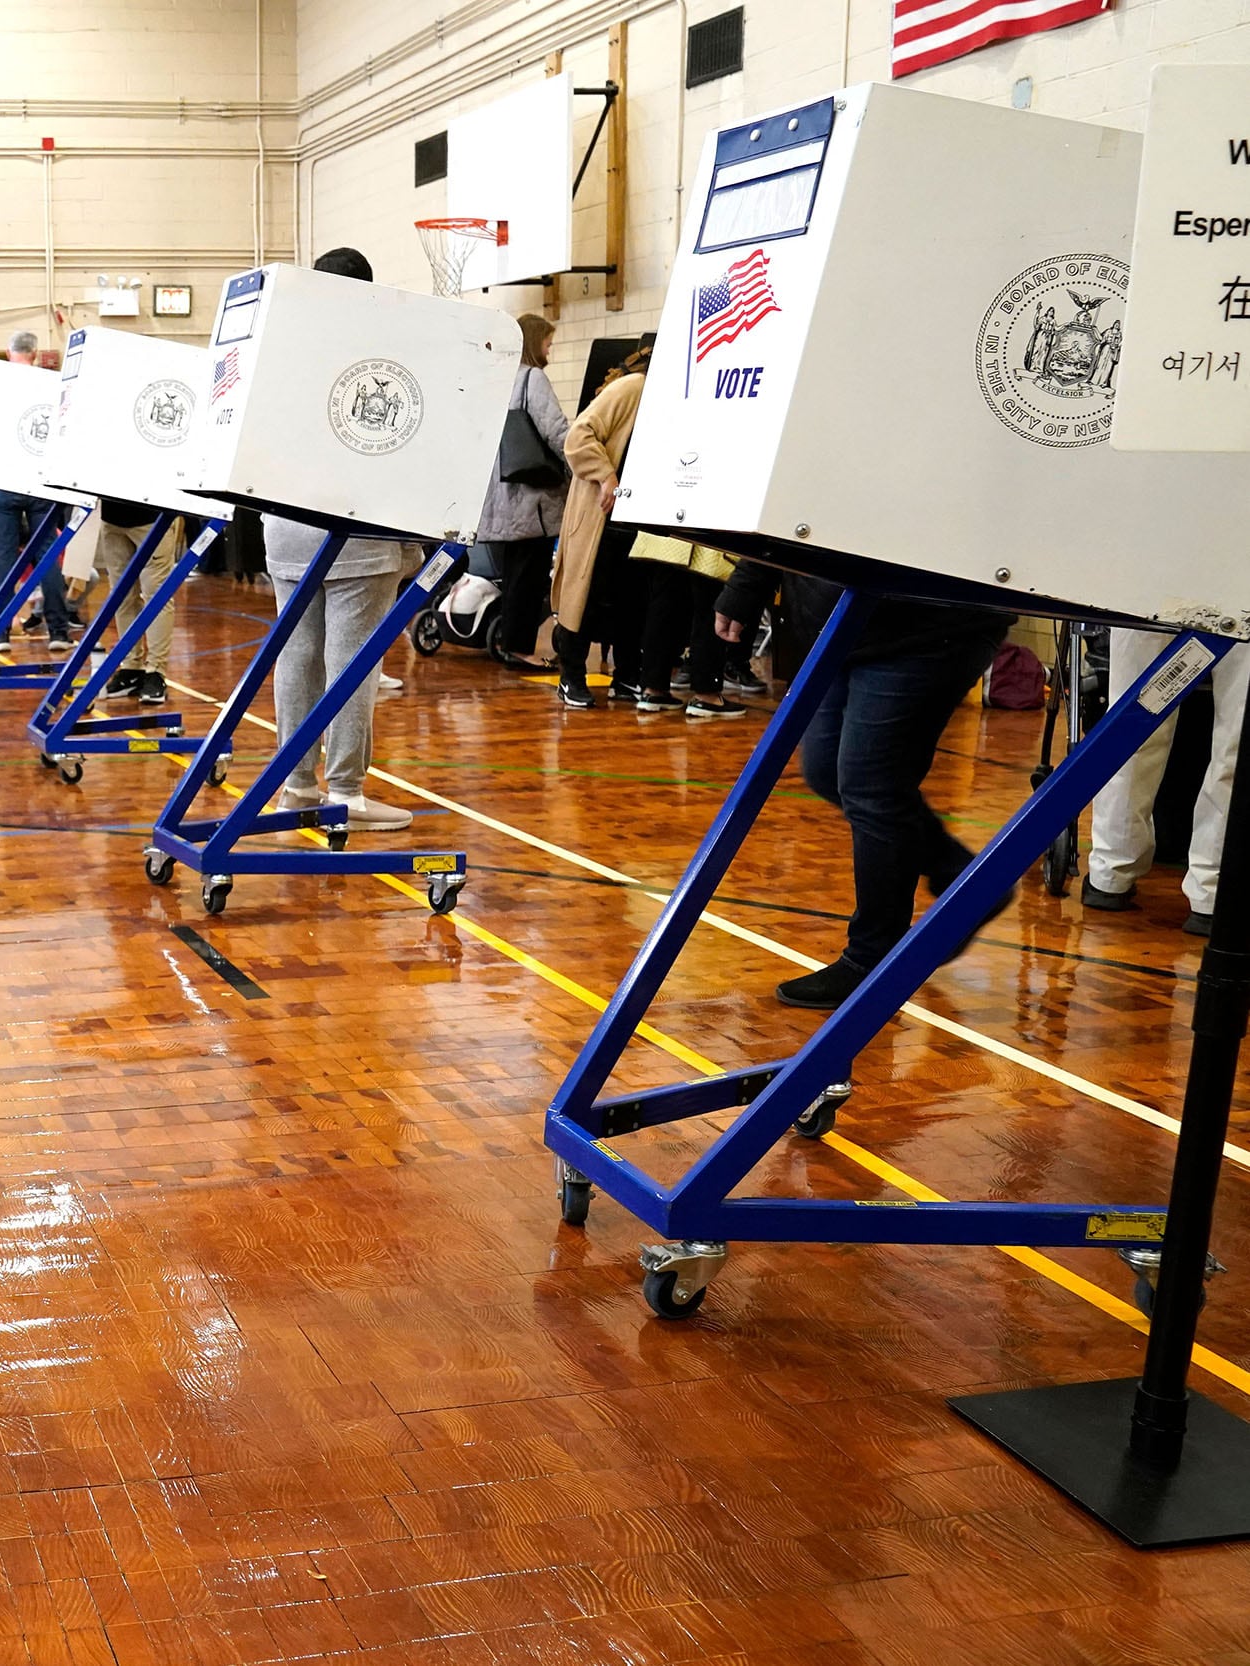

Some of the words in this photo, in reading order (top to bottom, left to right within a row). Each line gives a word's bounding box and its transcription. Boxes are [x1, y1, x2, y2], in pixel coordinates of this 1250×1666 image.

[582, 277, 589, 295] 3
[1000, 267, 1060, 314] BOARD
[1066, 263, 1091, 276] OF
[985, 334, 1000, 354] IN
[986, 360, 1006, 397] THE
[1162, 351, 1240, 381] 여기서
[714, 367, 764, 399] VOTE
[1041, 384, 1084, 397] EXCELSIOR
[1002, 399, 1041, 429] CITY
[1043, 423, 1069, 437] OF
